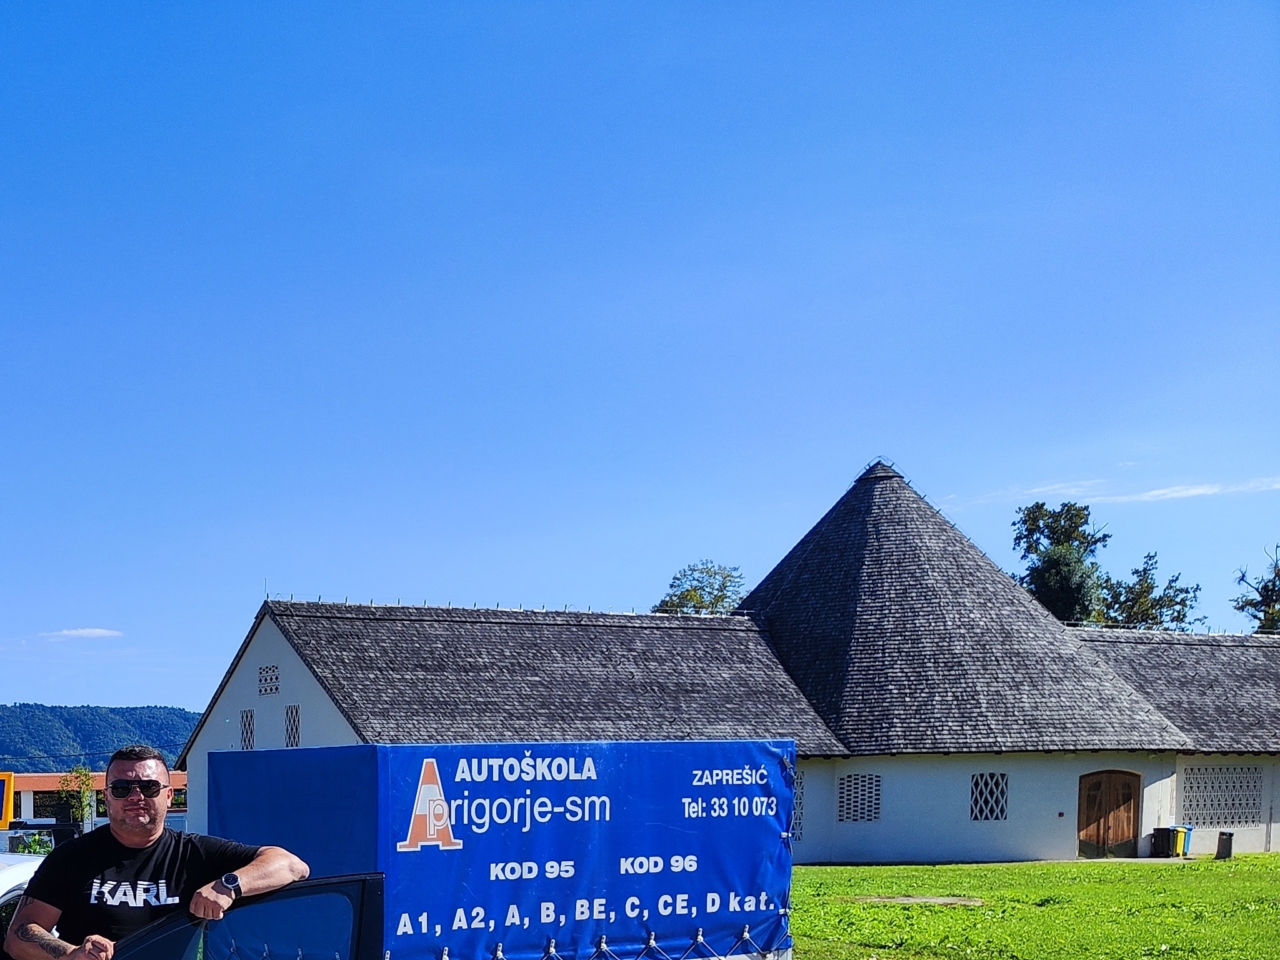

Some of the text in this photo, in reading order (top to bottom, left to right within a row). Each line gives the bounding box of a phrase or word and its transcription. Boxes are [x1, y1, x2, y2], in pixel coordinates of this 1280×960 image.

[455, 750, 597, 781] AUTOŠKOLA
[692, 764, 768, 785] ZAPREŠIĆ
[682, 796, 777, 818] Tel: 33 10 073
[489, 861, 575, 880] KOD 95
[620, 855, 698, 874] KOD 96
[90, 879, 179, 907] KARL
[396, 892, 775, 937] A1, A2, A, B, BE, C, CE, D kat.
